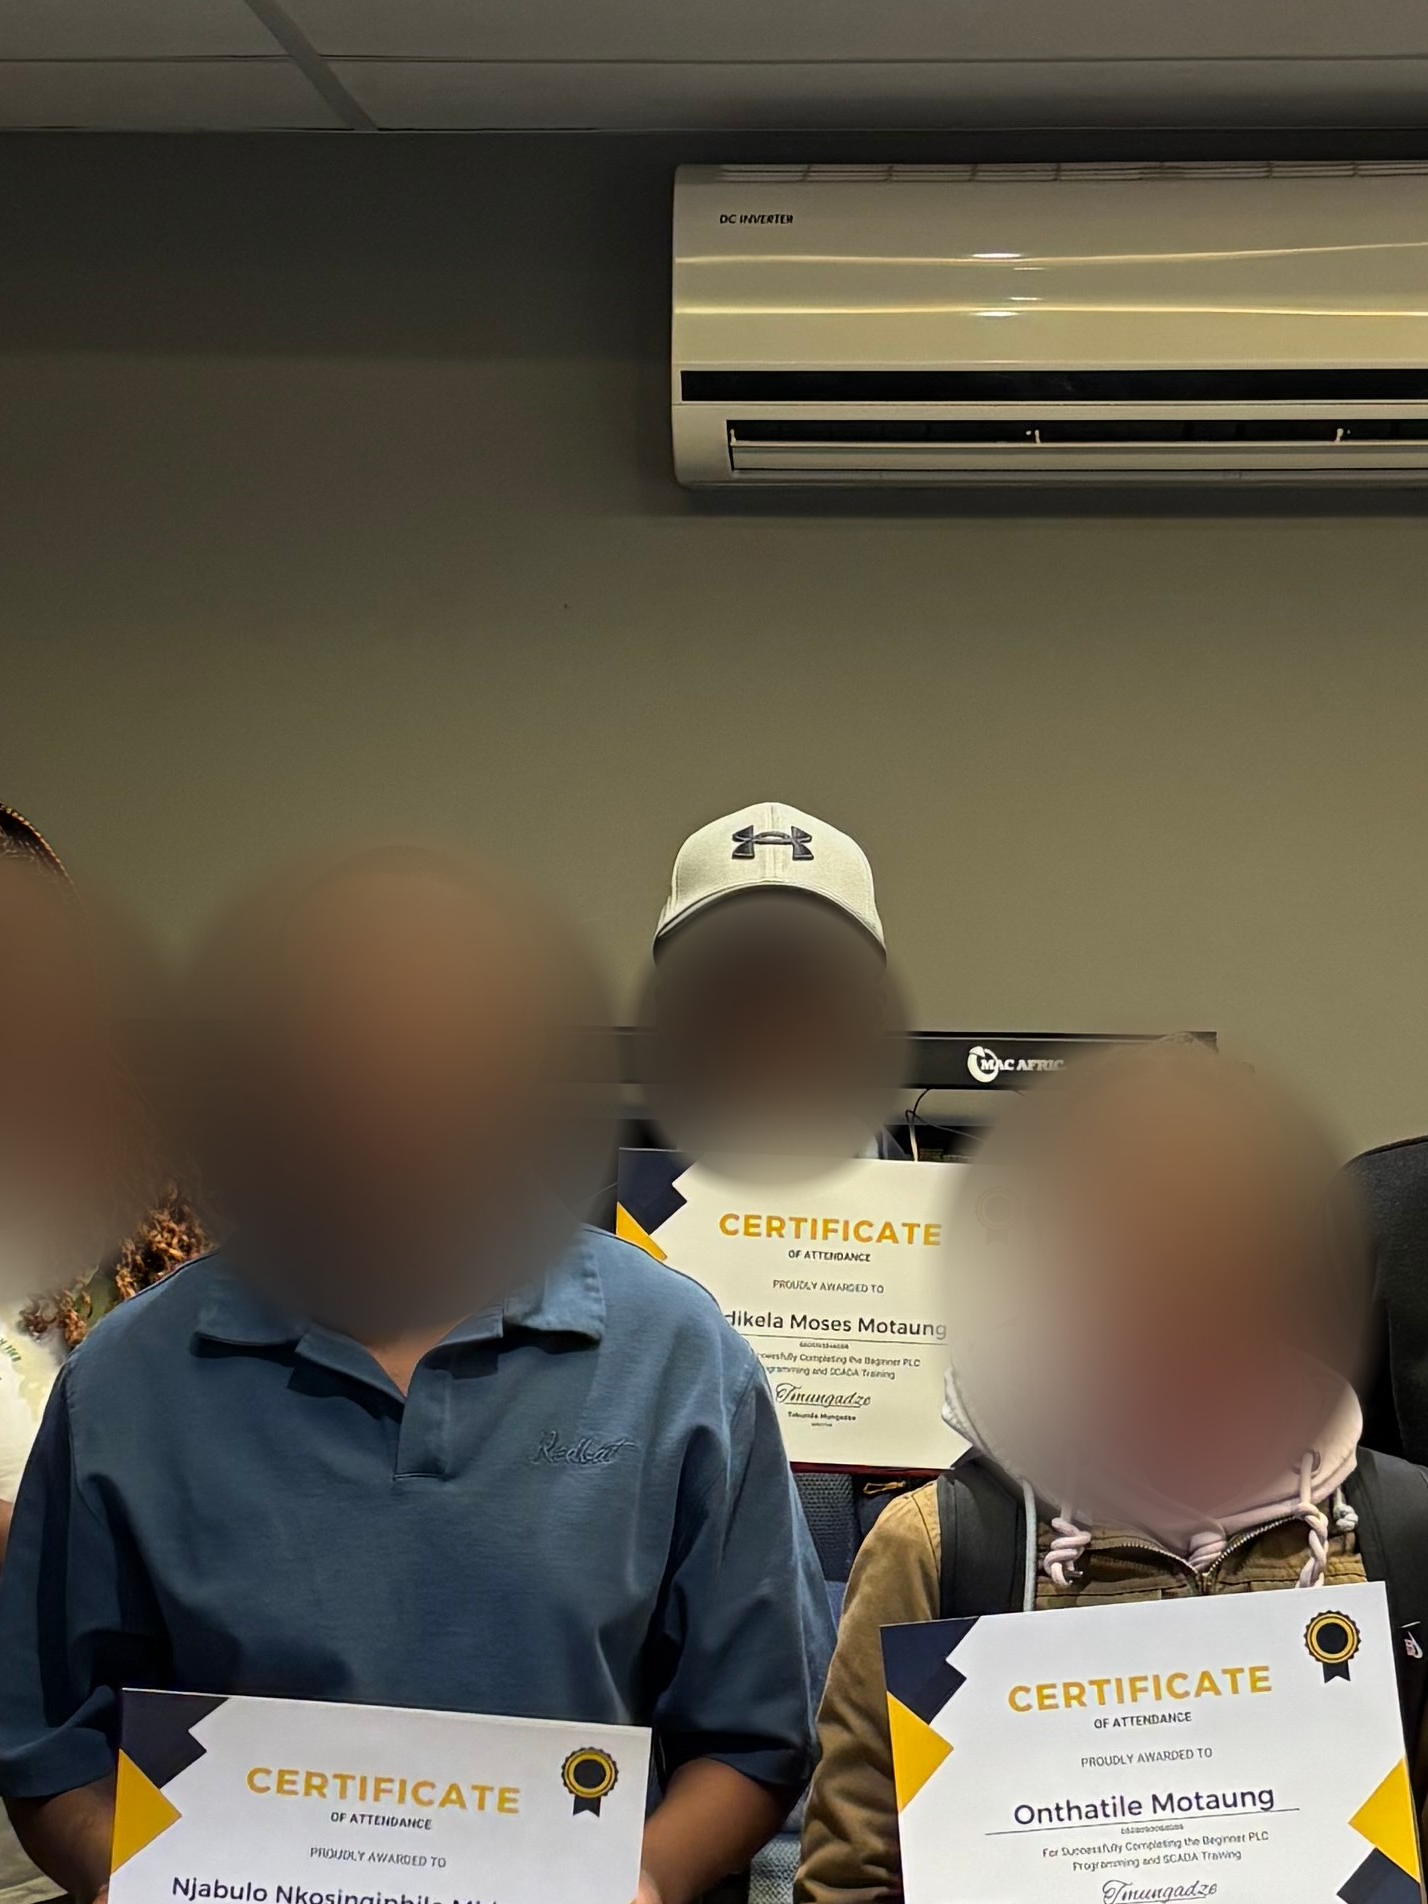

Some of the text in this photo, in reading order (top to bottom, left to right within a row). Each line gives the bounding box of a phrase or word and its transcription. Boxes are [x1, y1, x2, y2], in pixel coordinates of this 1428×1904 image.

[719, 214, 737, 224] DC
[1016, 1059, 1067, 1071] AFRIC
[719, 1213, 942, 1246] CERTIFICATE
[791, 1314, 851, 1332] Moses
[858, 1318, 946, 1340] Motaung
[1008, 1666, 1272, 1712] CERTIFICATE
[1094, 1712, 1192, 1729] OF ATTENDANCE
[1081, 1748, 1212, 1767] PROUDLY AWARDED TO
[247, 1767, 520, 1814] CERTIFICATE
[1014, 1789, 1276, 1825] Onthatile Motaung
[331, 1812, 346, 1822] OF
[1249, 1831, 1268, 1841] PLC
[431, 1856, 446, 1868] TO
[173, 1877, 267, 1902] Njabulo
